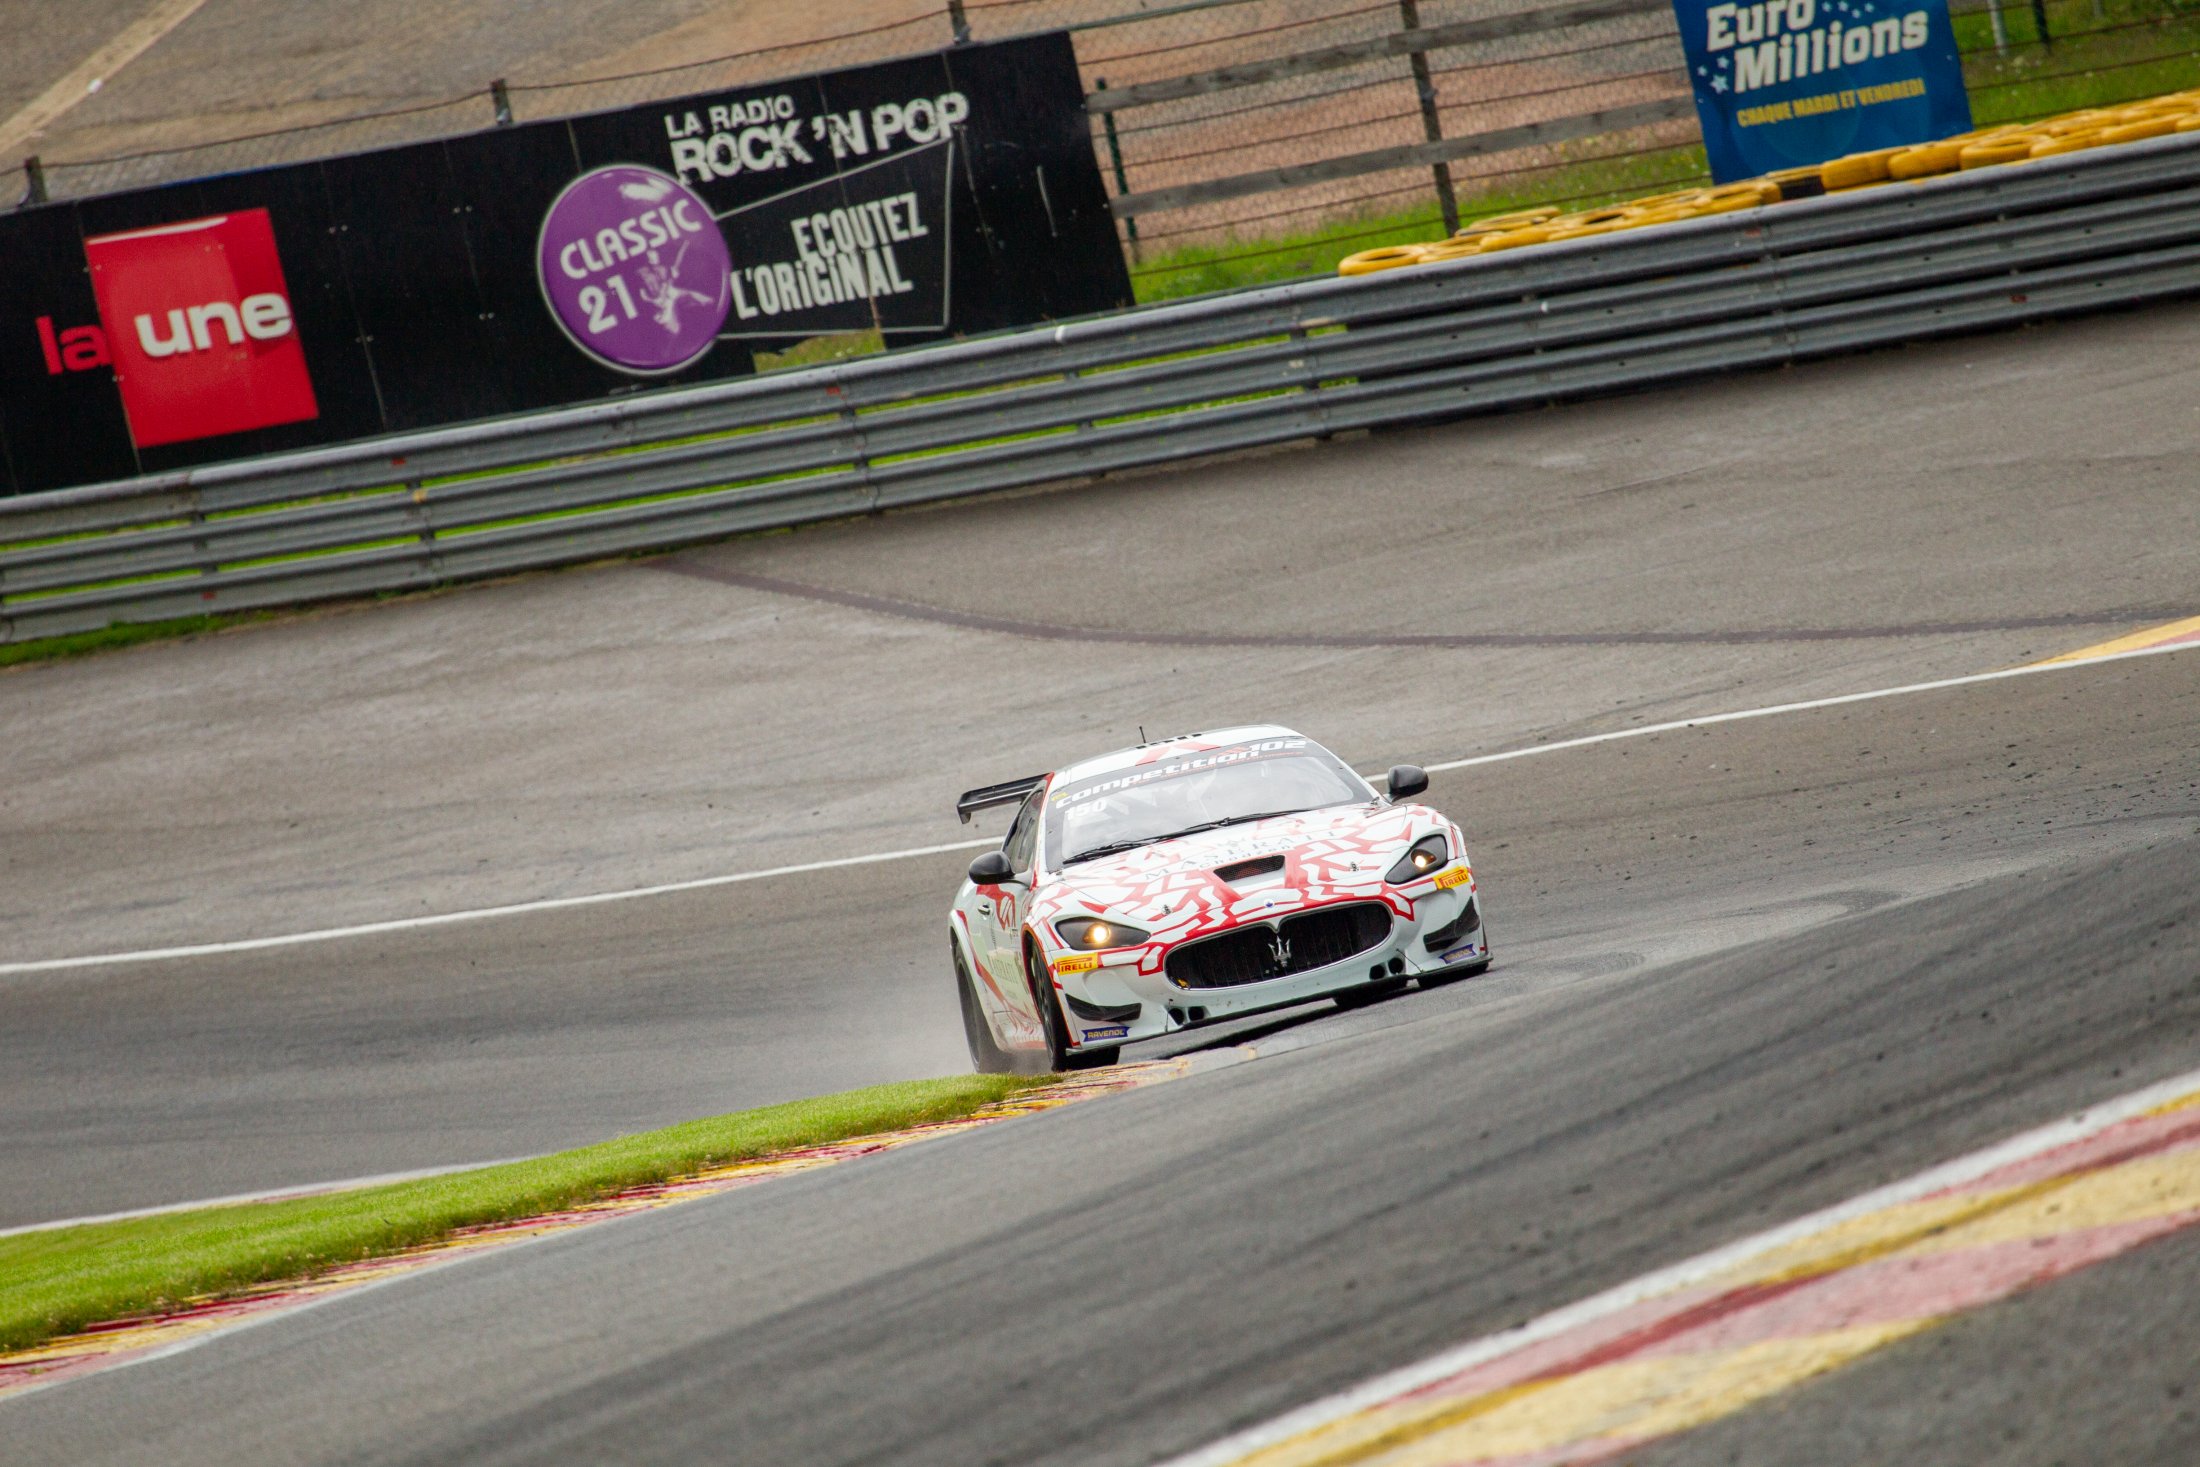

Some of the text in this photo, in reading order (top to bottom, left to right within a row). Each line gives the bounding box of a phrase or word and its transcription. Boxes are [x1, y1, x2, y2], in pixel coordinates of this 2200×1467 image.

[1706, 0, 1815, 52] Euro
[1734, 10, 1928, 94] Millions
[664, 95, 795, 139] LA RADIO
[1737, 77, 1926, 128] CHAQUE MARDI ET VENDREDI
[670, 119, 813, 185] ROCK
[871, 92, 969, 150] POP
[560, 199, 702, 280] CLASSIC
[790, 192, 929, 262] ECOUTEZ
[578, 274, 638, 335] 21
[35, 293, 293, 376] la une
[1065, 800, 1108, 821] 150
[1438, 869, 1467, 888] PIRELLI
[1056, 957, 1093, 973] PIRELLI
[1087, 1029, 1125, 1039] RAVENOL
